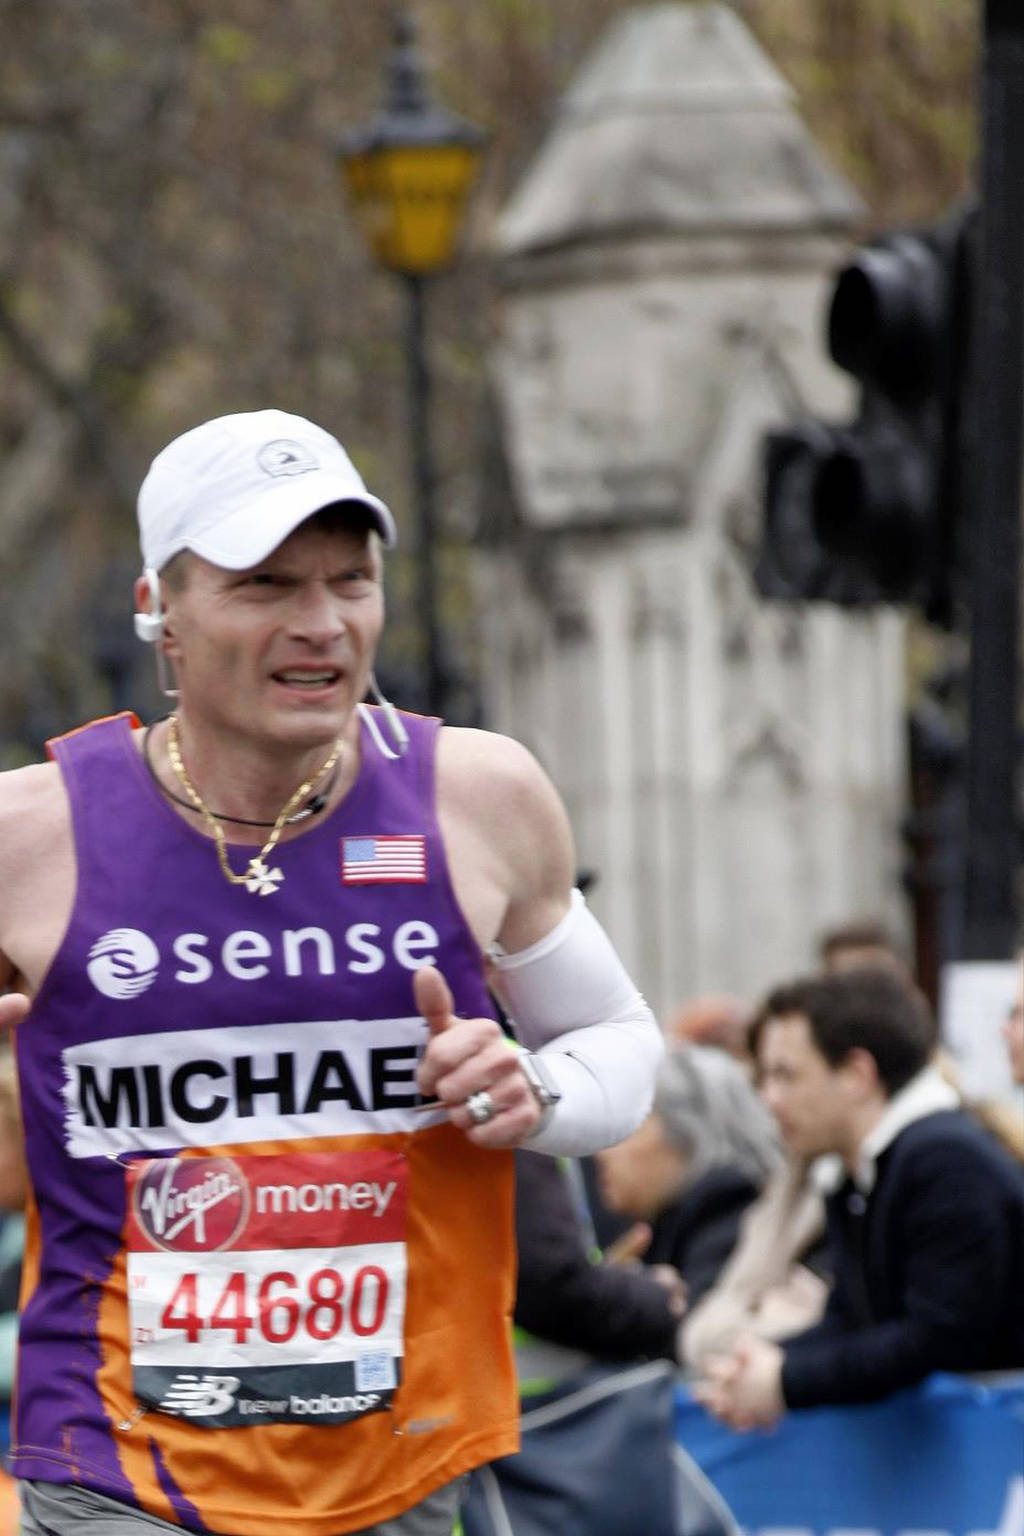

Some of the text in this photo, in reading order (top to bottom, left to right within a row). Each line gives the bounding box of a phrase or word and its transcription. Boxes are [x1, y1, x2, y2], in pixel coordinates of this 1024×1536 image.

[174, 920, 441, 983] sense
[77, 1044, 440, 1129] MICHAE
[140, 1158, 397, 1243] Virgin money
[161, 1265, 390, 1344] 44680
[238, 1399, 289, 1415] new
